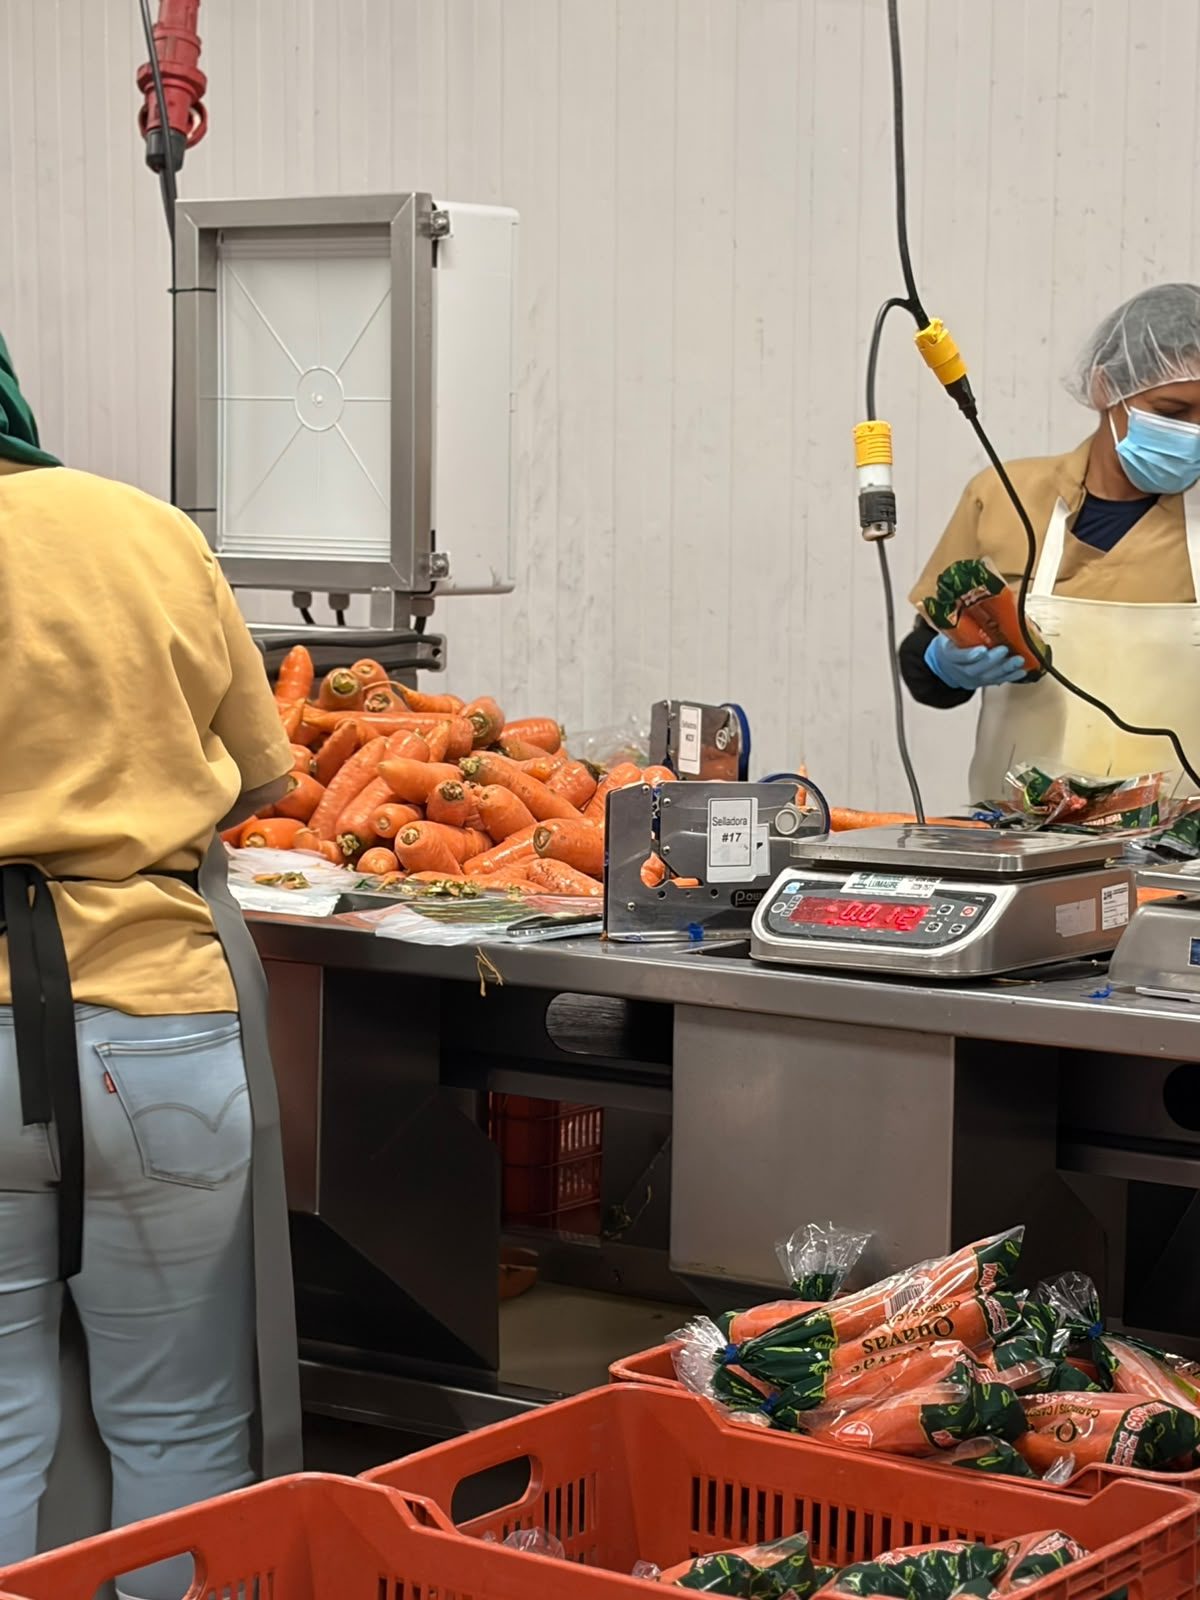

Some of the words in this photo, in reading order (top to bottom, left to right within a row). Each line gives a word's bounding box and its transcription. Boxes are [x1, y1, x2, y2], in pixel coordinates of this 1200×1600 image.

[712, 816, 748, 827] Selladora
[721, 832, 742, 843] #17
[861, 1315, 955, 1354] Quavas
